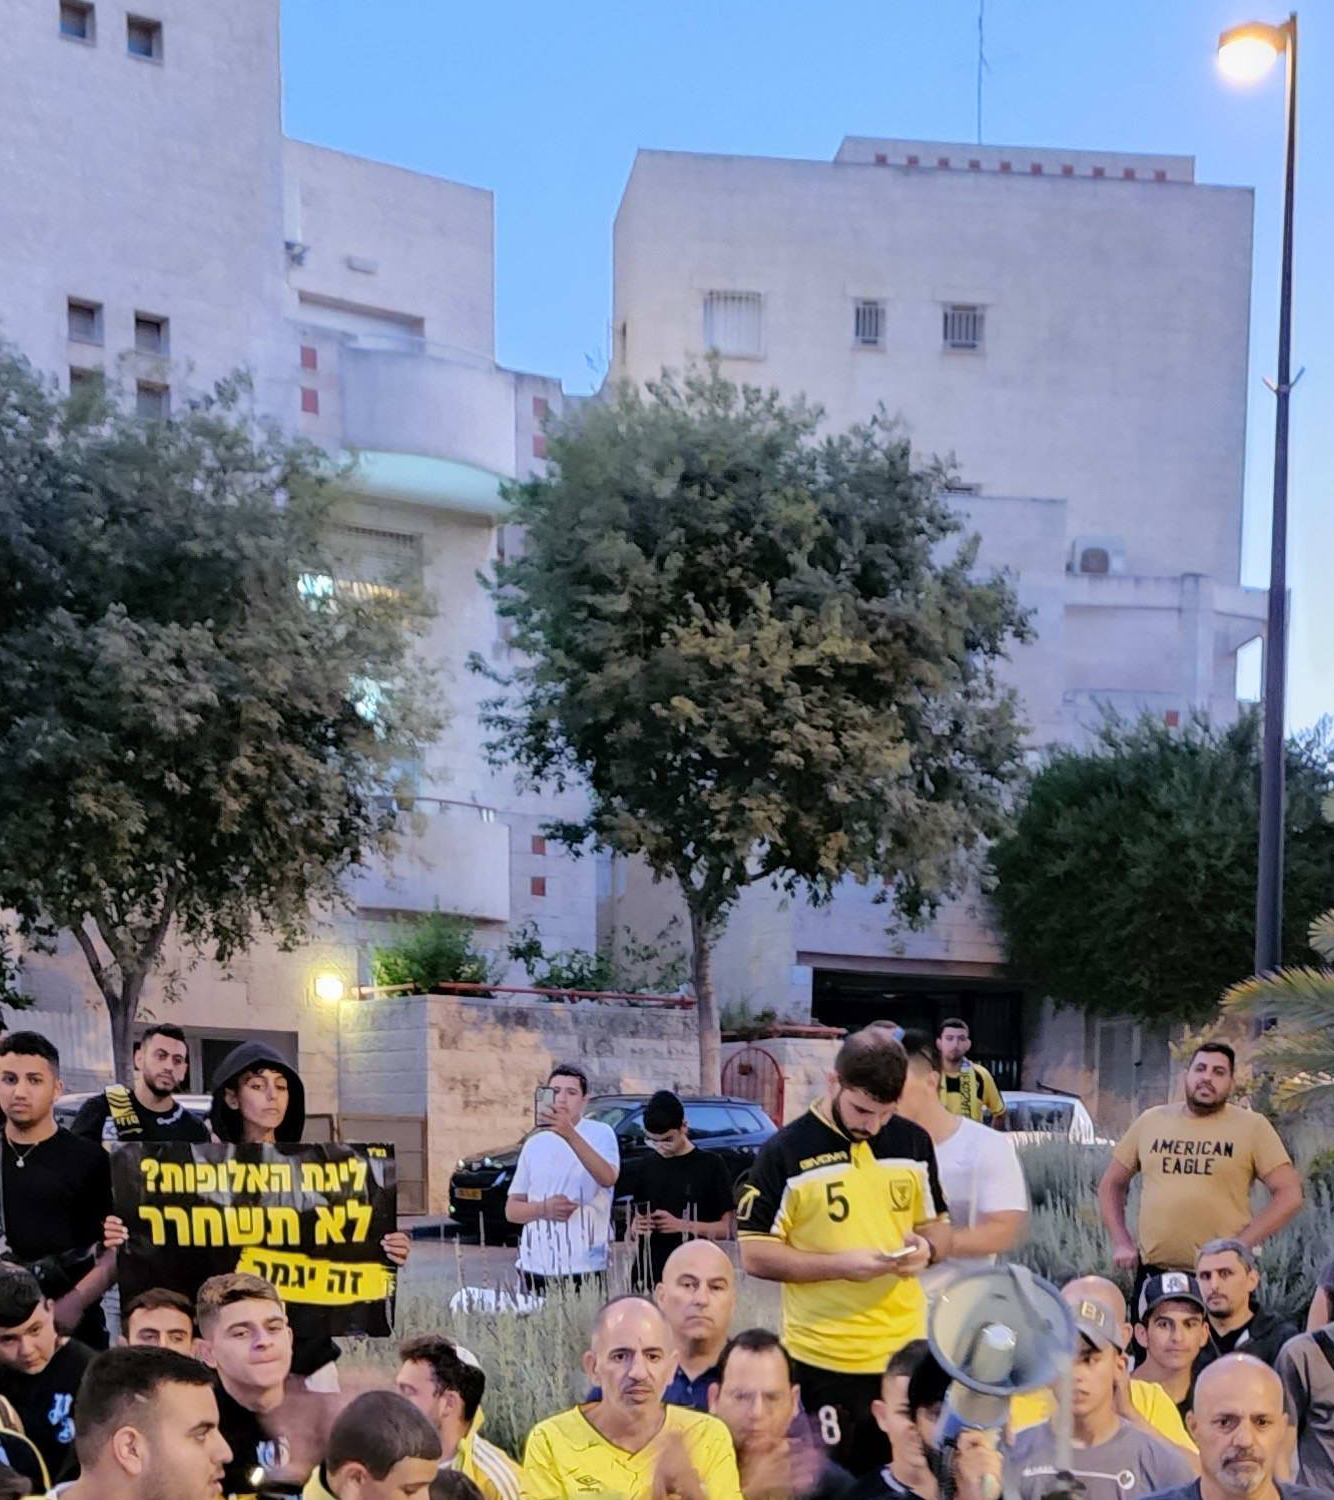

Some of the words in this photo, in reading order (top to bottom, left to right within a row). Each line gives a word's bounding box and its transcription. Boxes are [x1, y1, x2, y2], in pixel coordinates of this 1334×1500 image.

[1149, 1138, 1234, 1160] AMERICAN
[1161, 1157, 1216, 1176] EAGLE
[139, 1157, 292, 1193] האלופות?
[300, 1157, 367, 1193] ליגת
[826, 1181, 850, 1222] 5
[138, 1204, 300, 1247] תשחרר
[315, 1198, 373, 1246] לא
[326, 1268, 363, 1296] זה
[819, 1404, 842, 1446] 8
